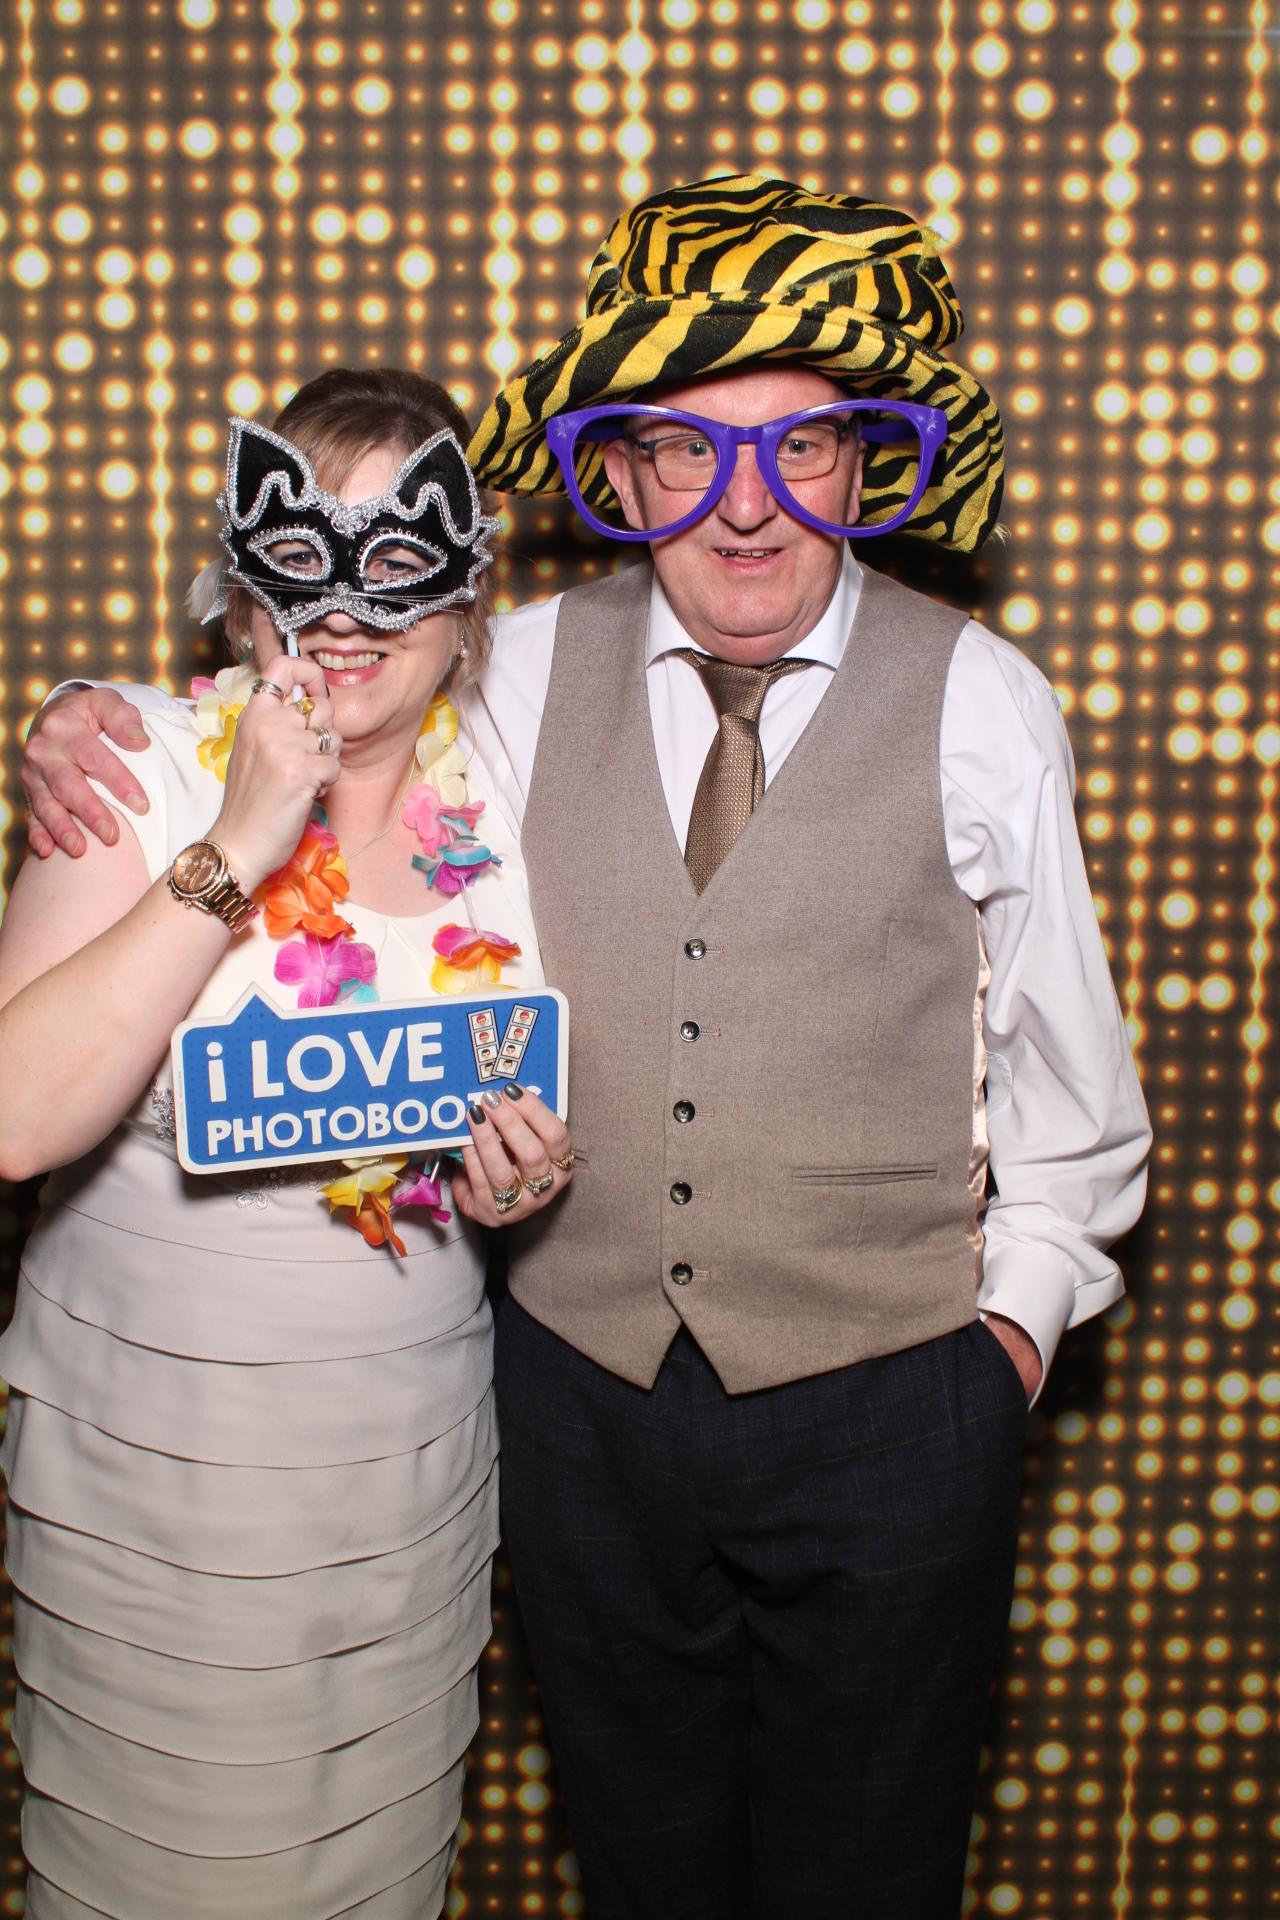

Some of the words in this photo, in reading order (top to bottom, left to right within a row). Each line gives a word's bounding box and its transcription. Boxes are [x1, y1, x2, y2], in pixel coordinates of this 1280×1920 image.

[206, 1041, 227, 1103] i
[251, 1022, 445, 1099] LOVE
[207, 1086, 542, 1156] PHOTOBOO
